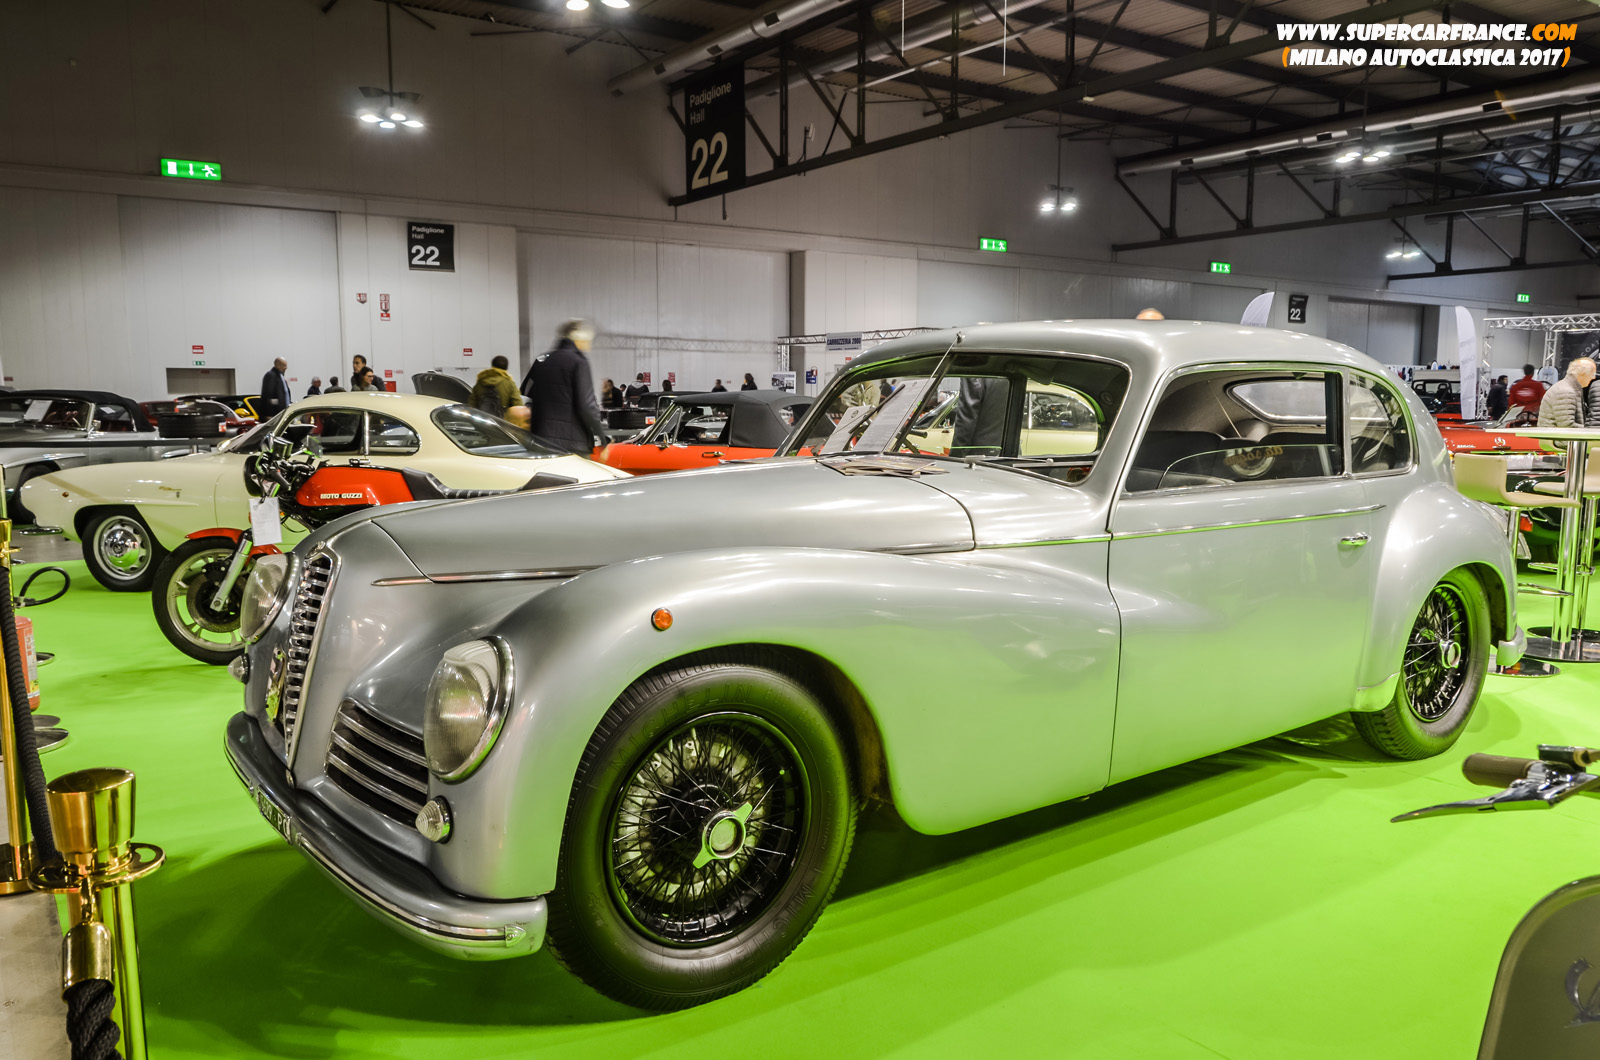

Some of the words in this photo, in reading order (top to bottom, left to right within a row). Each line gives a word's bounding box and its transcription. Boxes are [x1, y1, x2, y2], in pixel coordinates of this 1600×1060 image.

[689, 82, 732, 107] Padiglione
[690, 108, 705, 125] Hall
[691, 131, 728, 190] 22
[412, 225, 445, 234] Padiglione
[411, 245, 440, 266] 22
[1289, 307, 1301, 321] 22
[608, 683, 753, 771] MICHELIN
